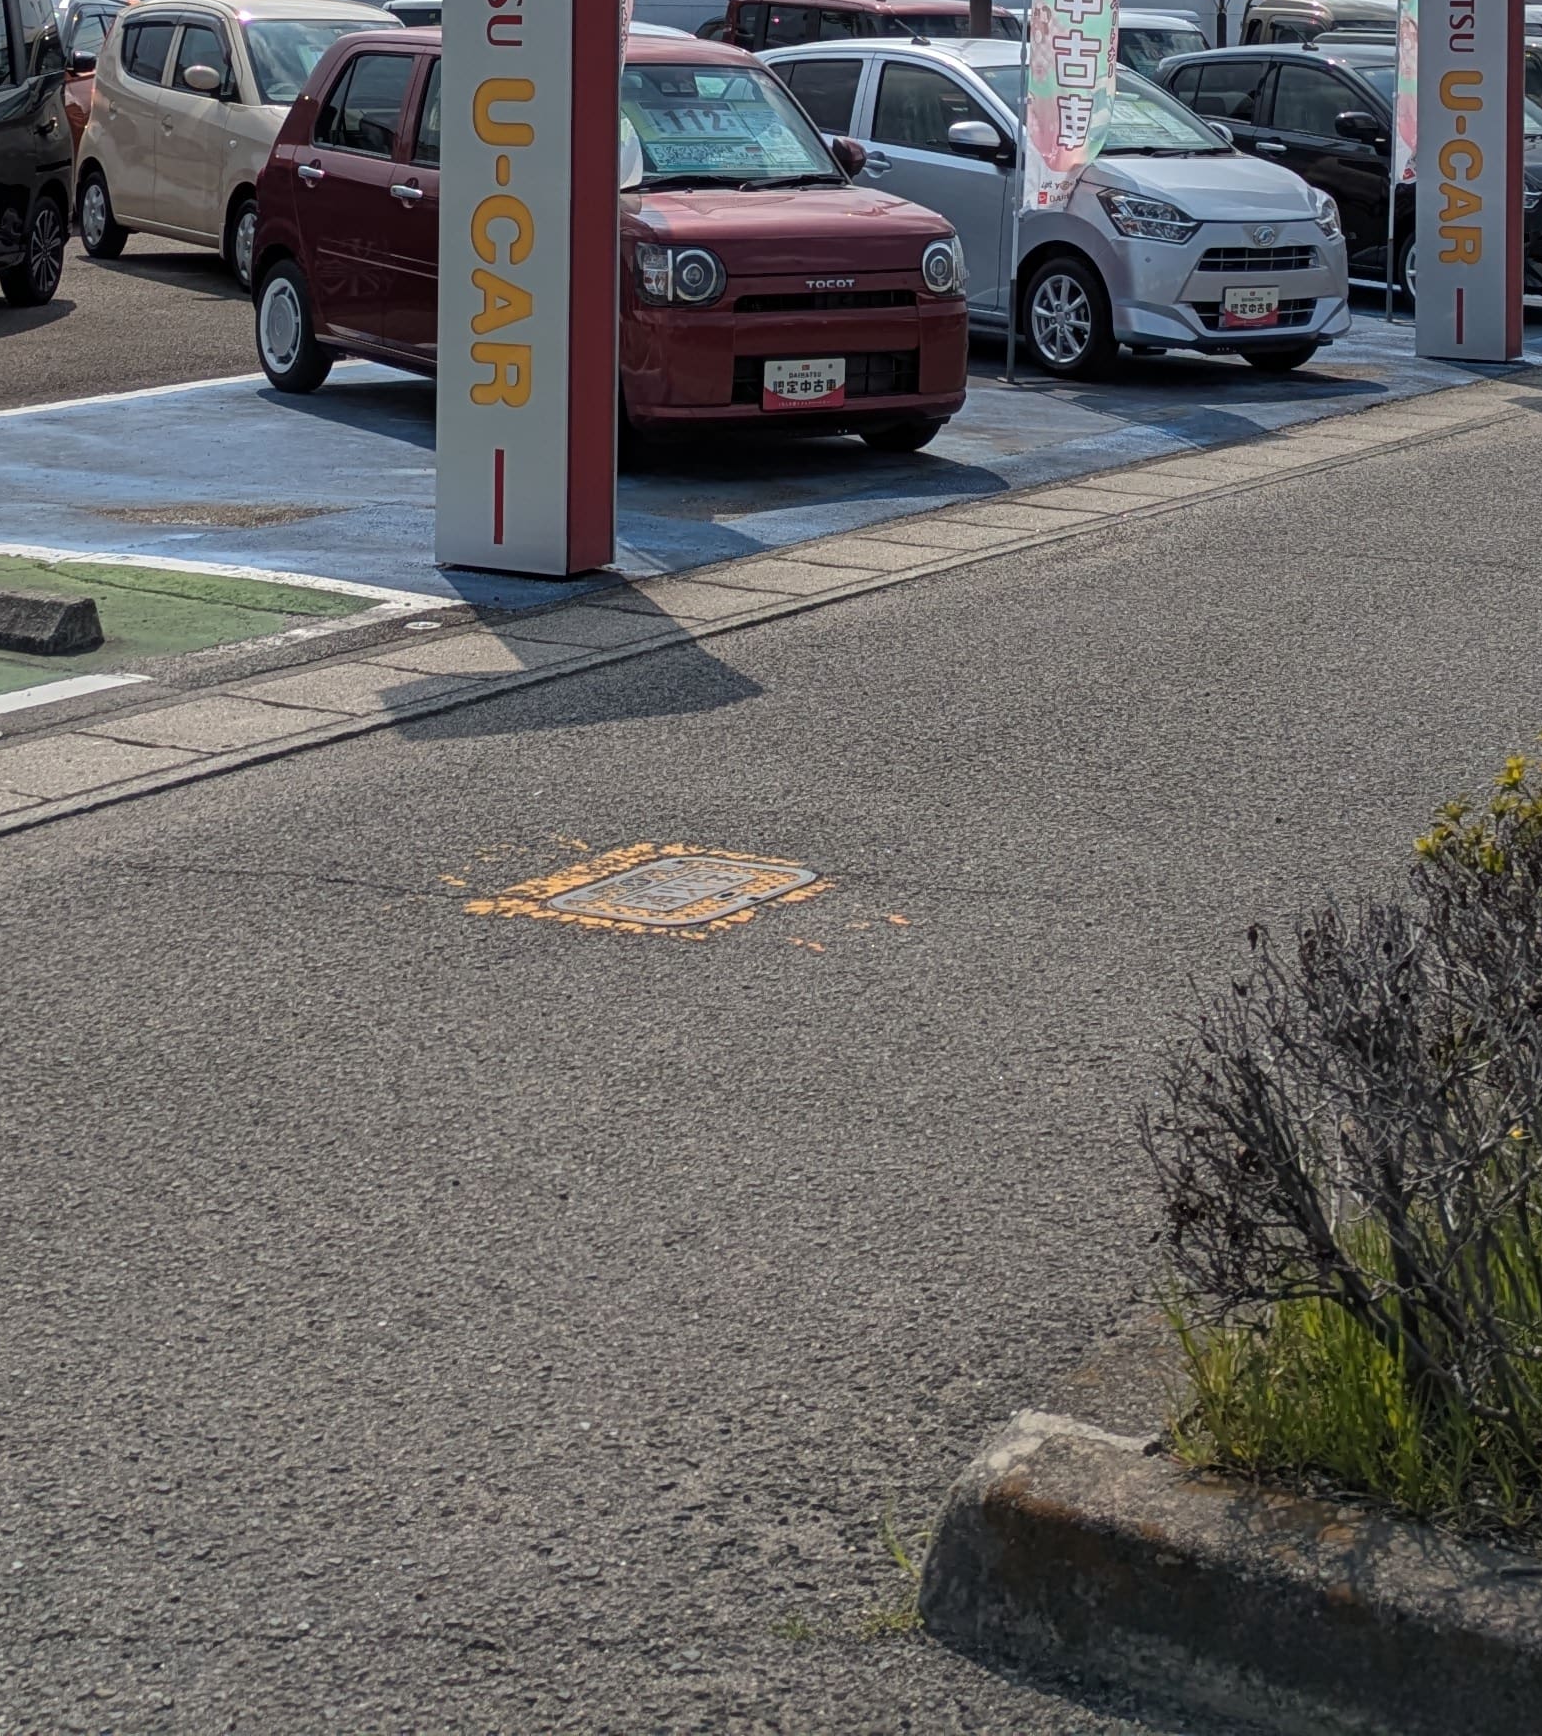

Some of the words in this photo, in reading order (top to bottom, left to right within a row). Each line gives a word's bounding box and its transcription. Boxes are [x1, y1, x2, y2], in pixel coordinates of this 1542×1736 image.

[1438, 70, 1483, 265] U-CAR
[470, 78, 536, 408] U-CAR
[806, 279, 855, 289] TOCOT
[773, 379, 836, 394] 認定中古車
